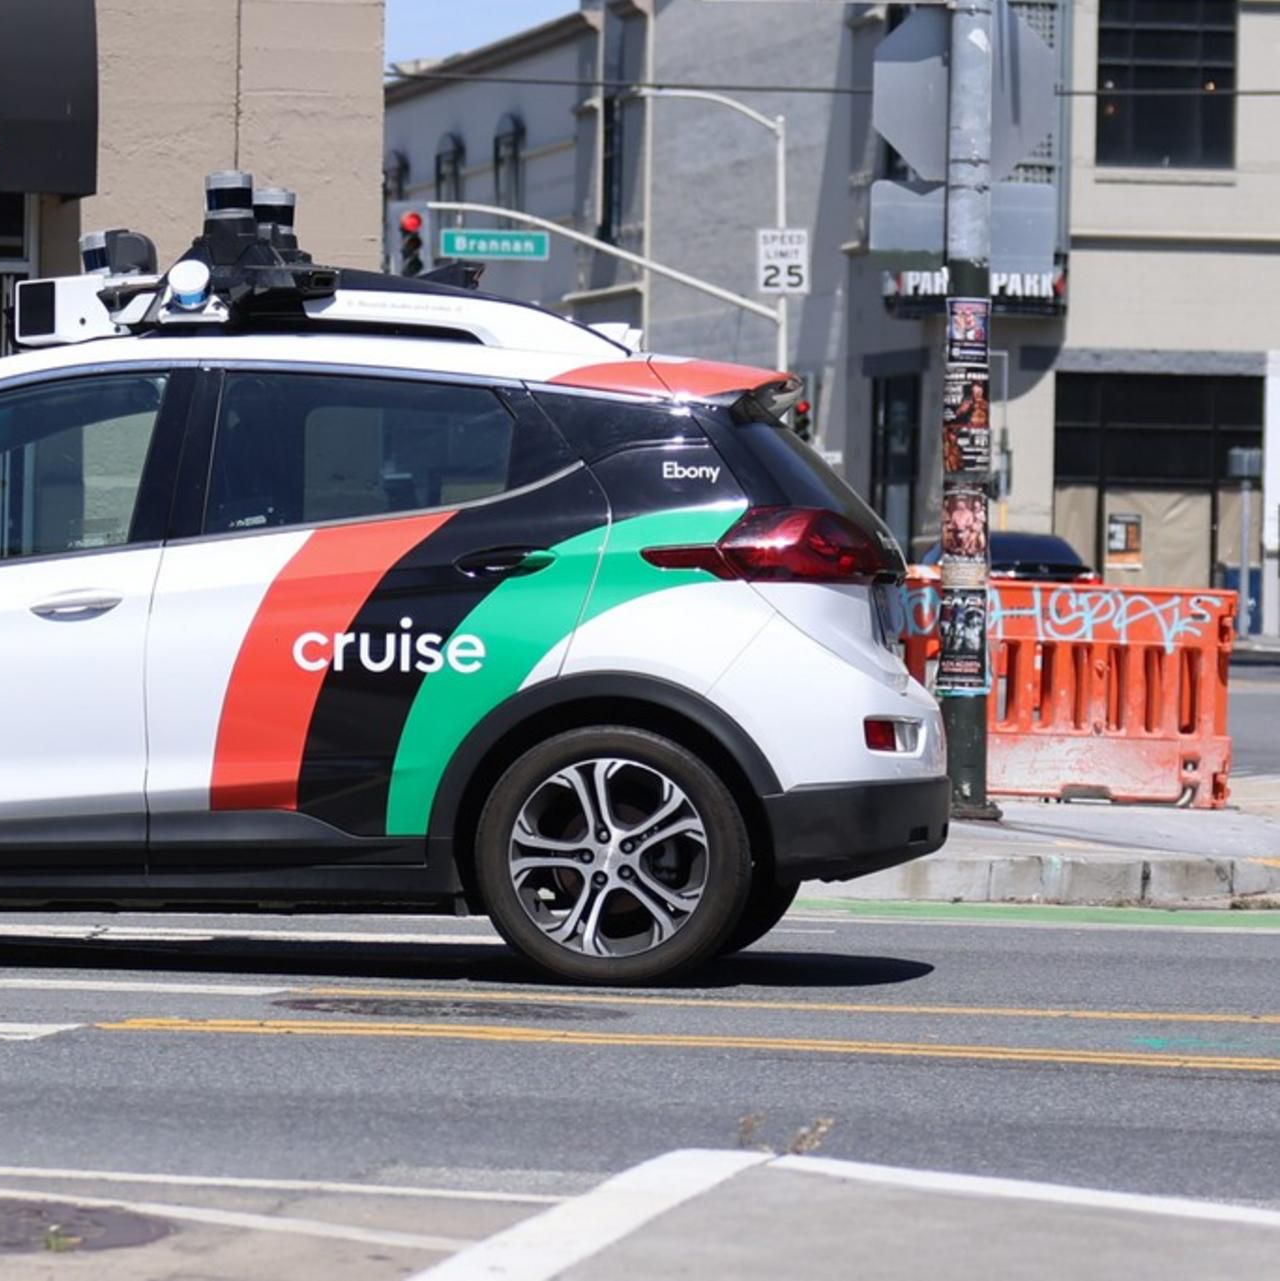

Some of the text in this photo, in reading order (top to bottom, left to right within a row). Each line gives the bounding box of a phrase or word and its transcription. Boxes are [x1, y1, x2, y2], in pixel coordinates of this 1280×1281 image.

[455, 235, 535, 253] Brannan
[762, 234, 806, 246] SPEED
[766, 248, 799, 260] LIMIT
[763, 264, 804, 288] 25
[662, 461, 720, 484] Ebony
[292, 617, 486, 675] cruise
